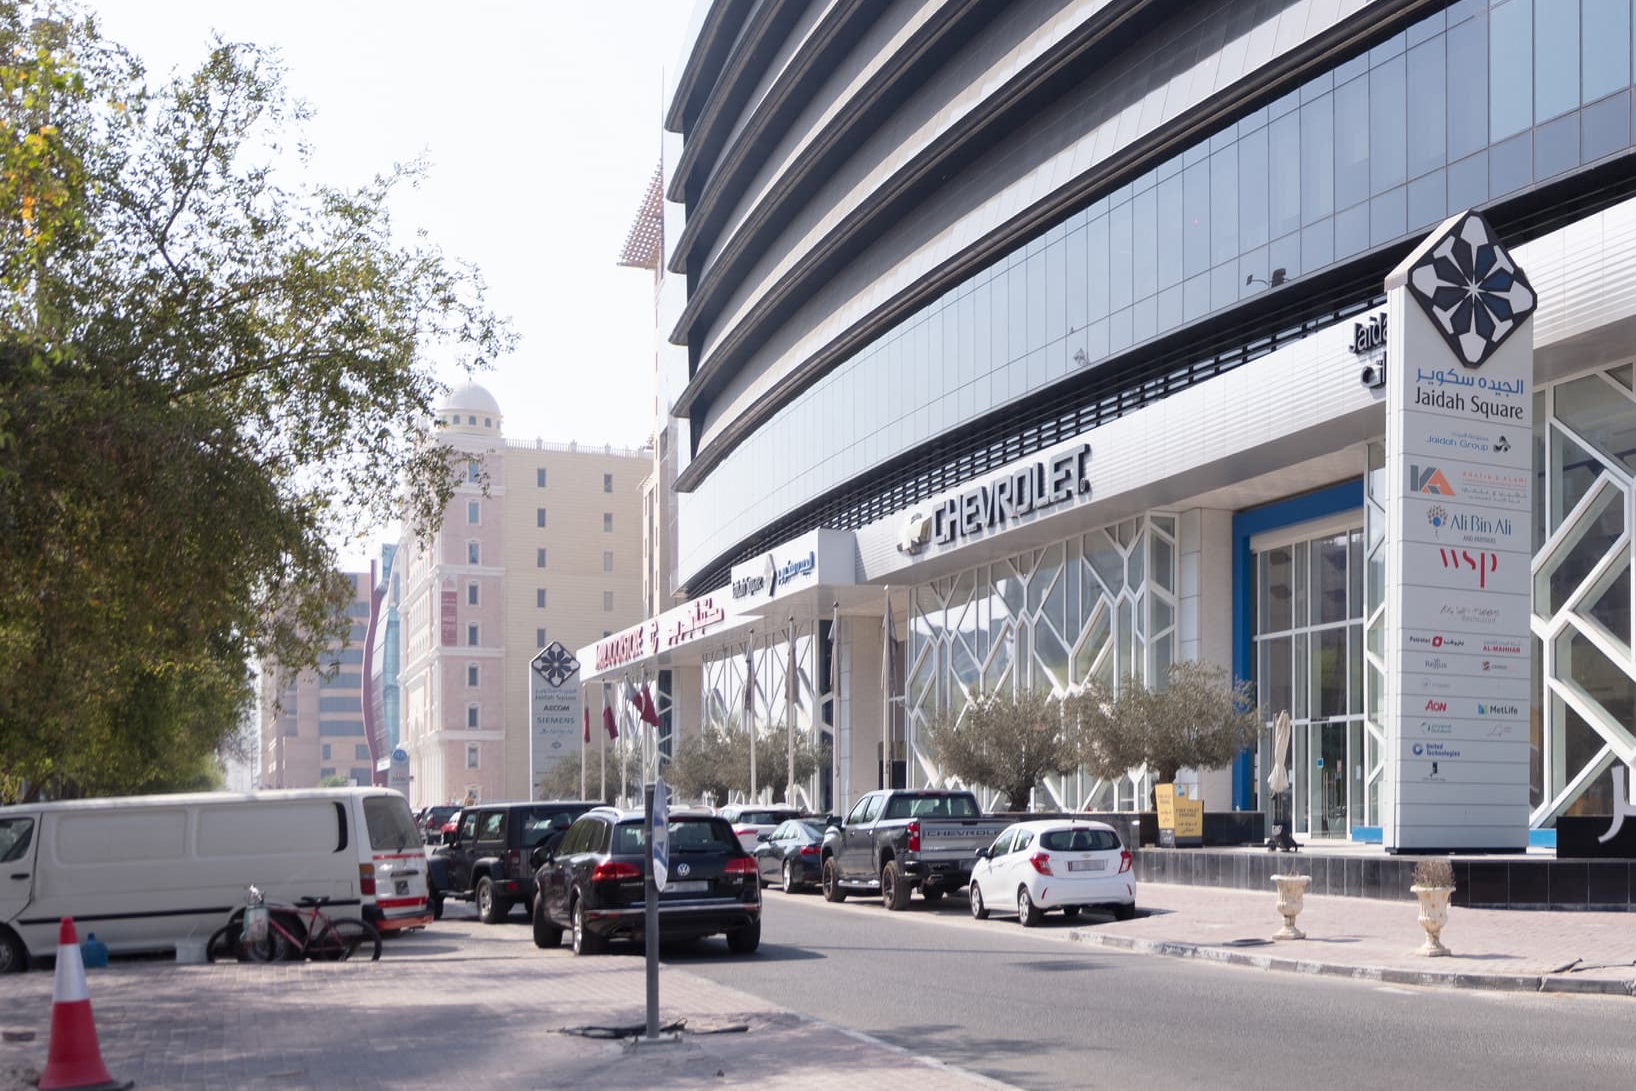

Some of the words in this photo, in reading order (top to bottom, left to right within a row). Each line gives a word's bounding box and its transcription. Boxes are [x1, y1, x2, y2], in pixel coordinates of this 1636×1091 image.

[1414, 386, 1465, 412] Jaidah
[1470, 395, 1524, 420] Square
[1425, 434, 1457, 447] Jaidah
[1459, 439, 1489, 452] Group
[931, 443, 1091, 545] CHEVROLET
[1450, 514, 1468, 531] Ali
[1471, 515, 1492, 533] Bin
[1494, 519, 1512, 536] Ali
[1489, 705, 1518, 715] MetLife
